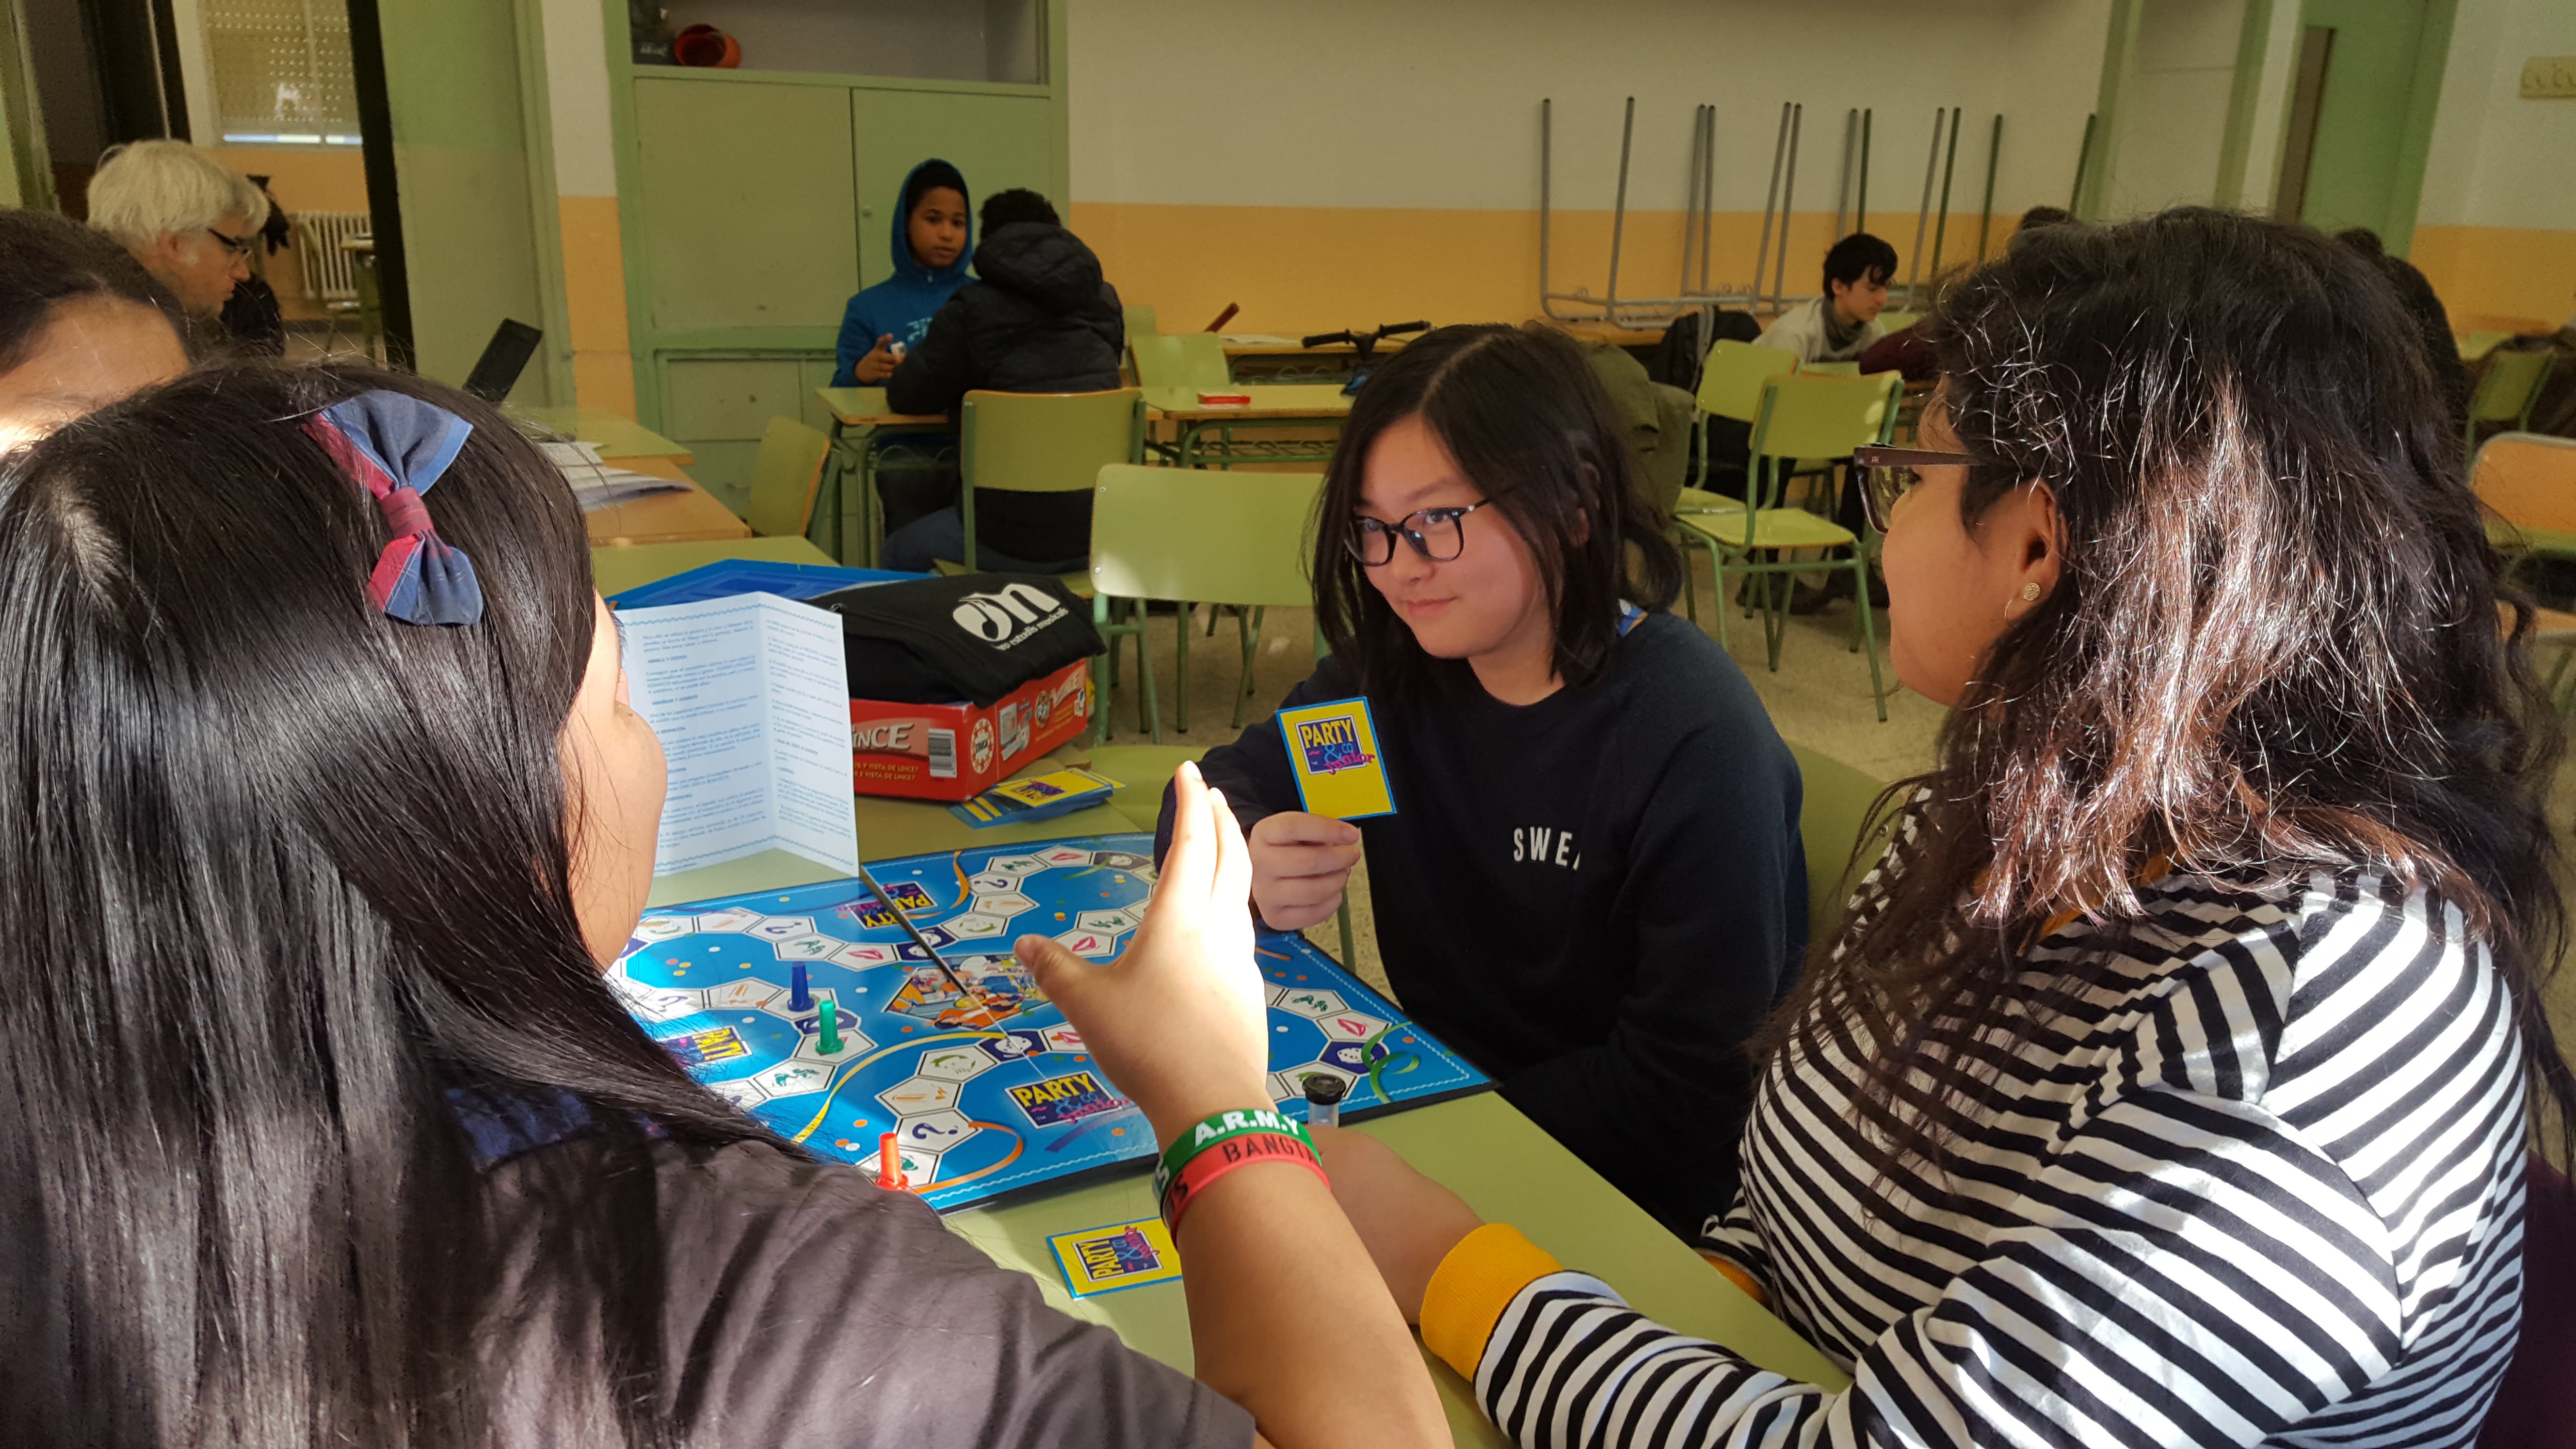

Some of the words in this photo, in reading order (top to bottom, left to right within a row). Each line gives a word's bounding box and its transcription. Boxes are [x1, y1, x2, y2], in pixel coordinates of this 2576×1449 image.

[1300, 719, 1353, 749] PARTY
[1013, 1073, 1095, 1108] PARTY
[1078, 1240, 1125, 1279] PARTY
